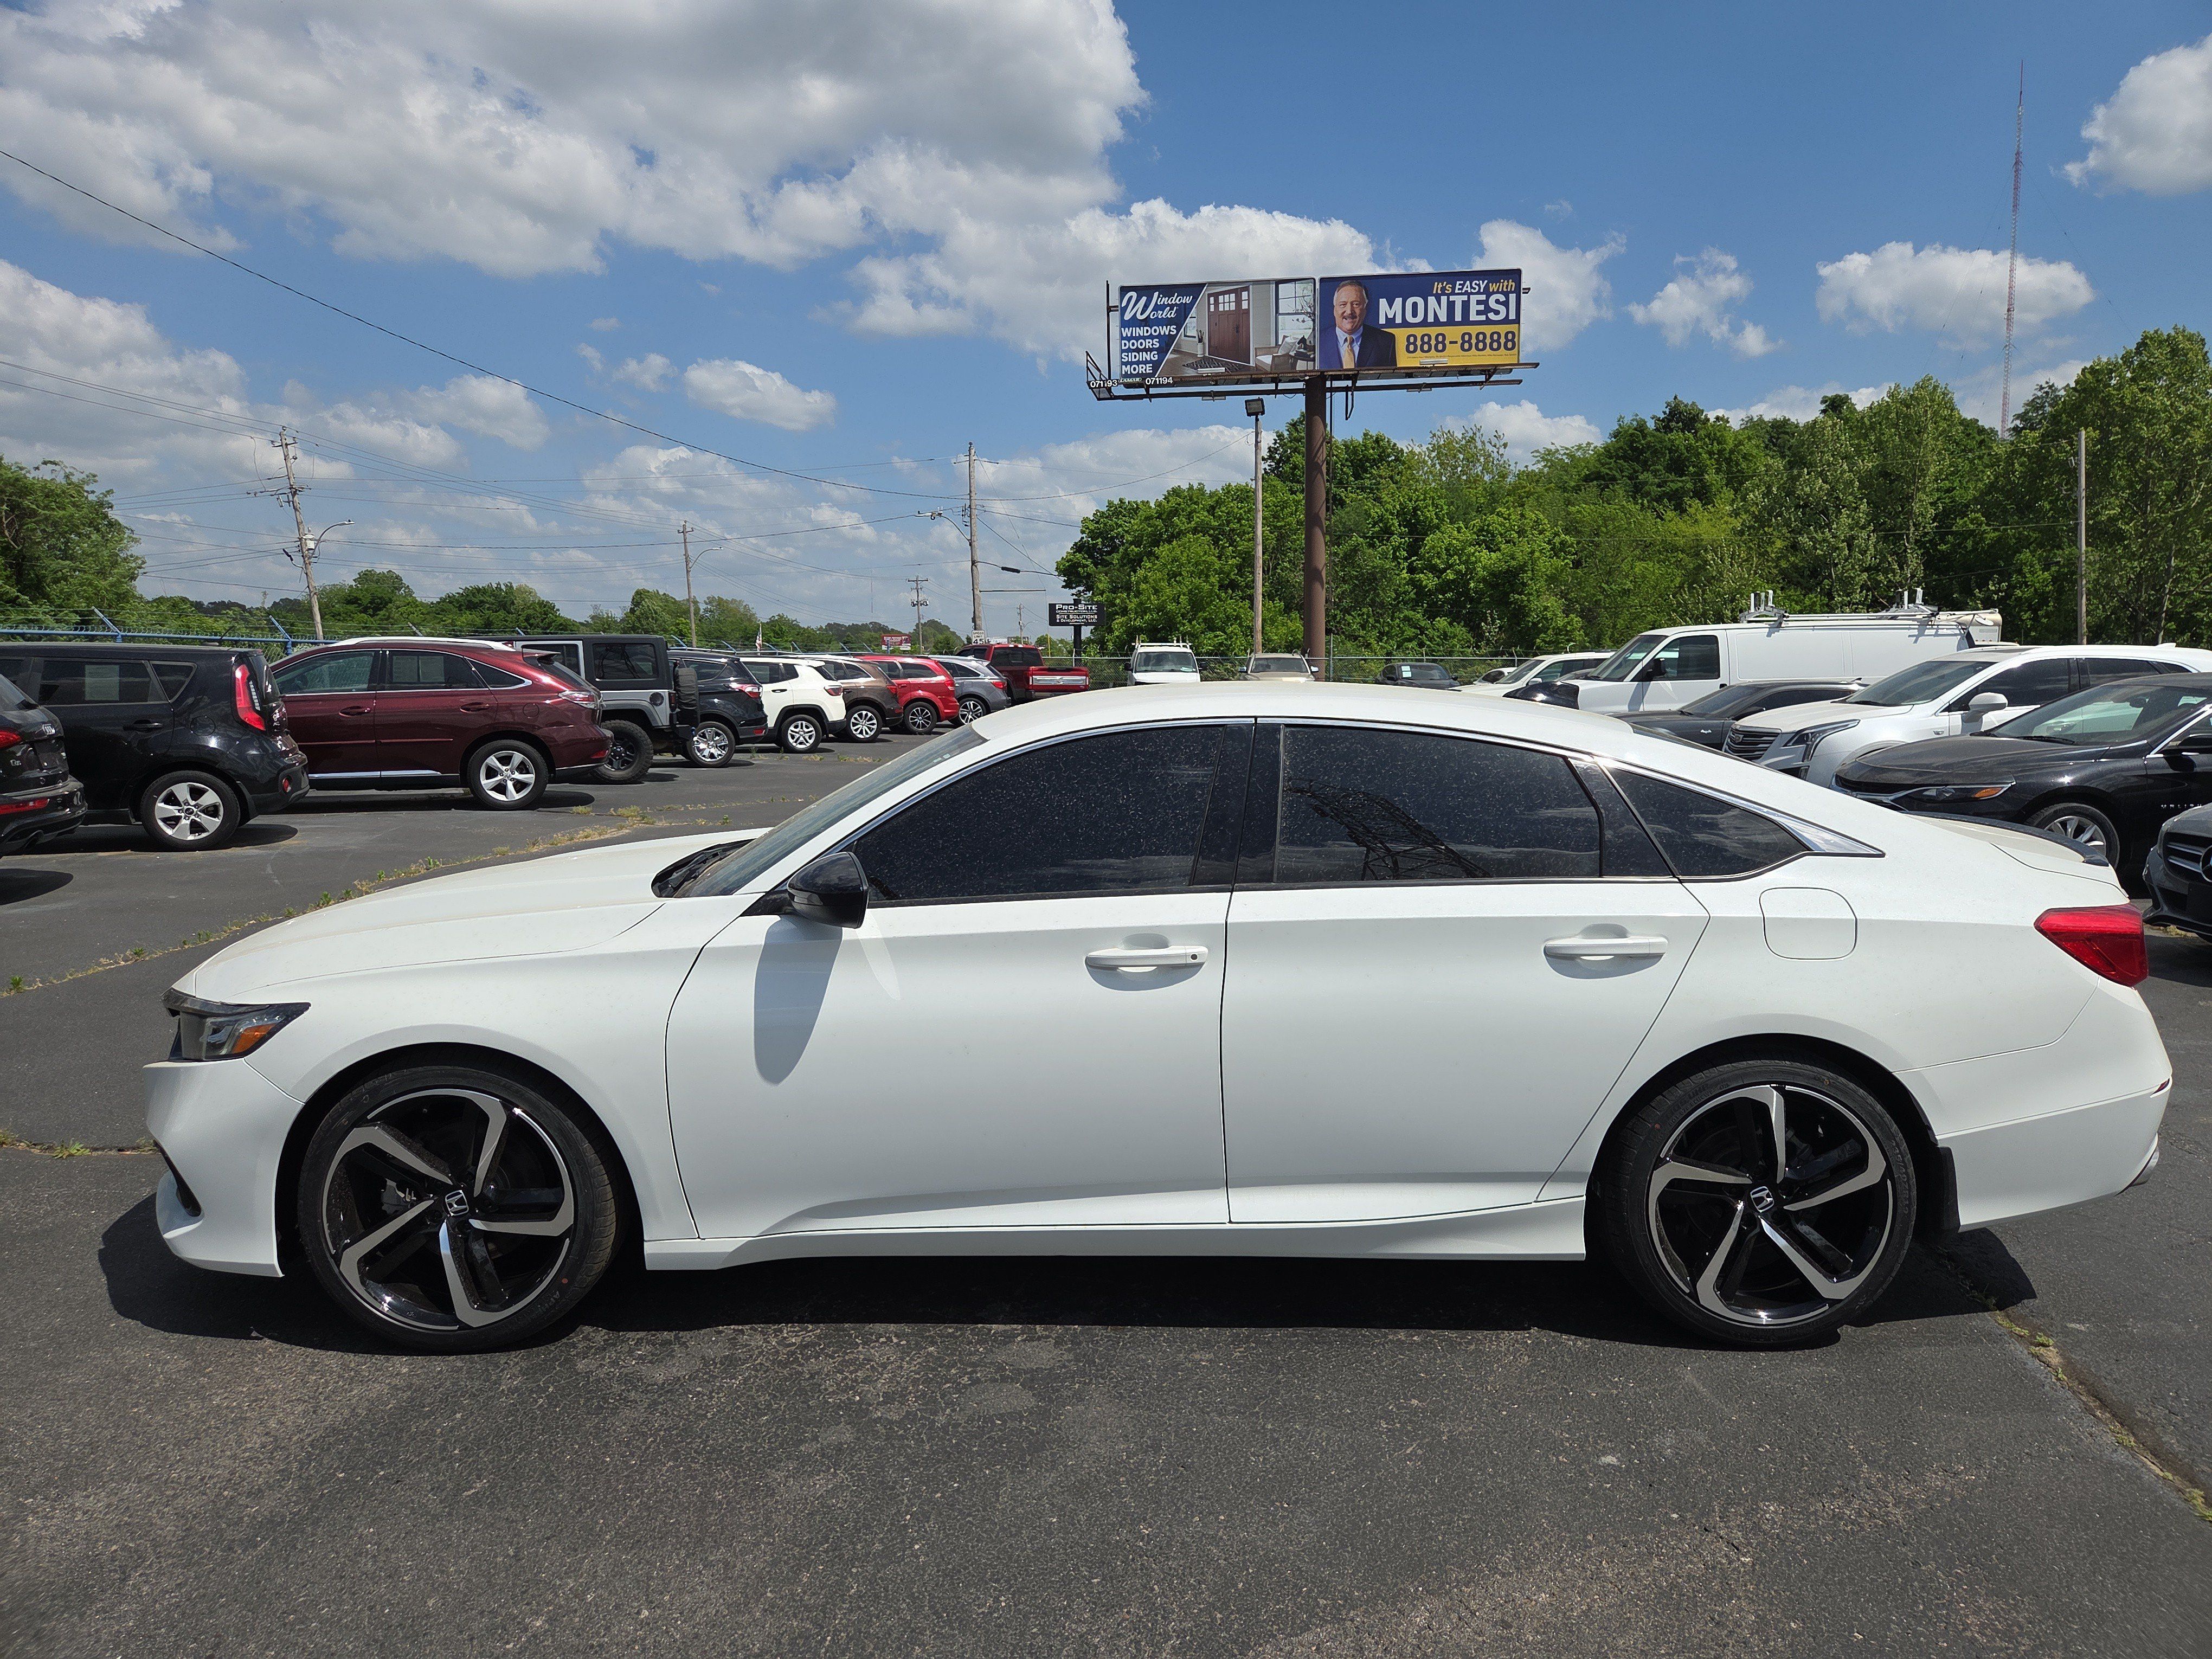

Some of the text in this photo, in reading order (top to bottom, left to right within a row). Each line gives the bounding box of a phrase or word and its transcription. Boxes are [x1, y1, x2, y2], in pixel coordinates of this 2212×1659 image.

[1433, 279, 1515, 294] It's EASY with
[1121, 291, 1193, 320] Window
[1379, 293, 1516, 324] MONTESI
[1121, 325, 1177, 337] WINDOWS
[1121, 338, 1160, 350] DOORS
[1405, 330, 1516, 354] 888-8888
[1121, 351, 1158, 362] SIDING
[1122, 364, 1153, 375] MORE
[1090, 380, 1118, 388] 071193
[1145, 377, 1173, 385] 071194
